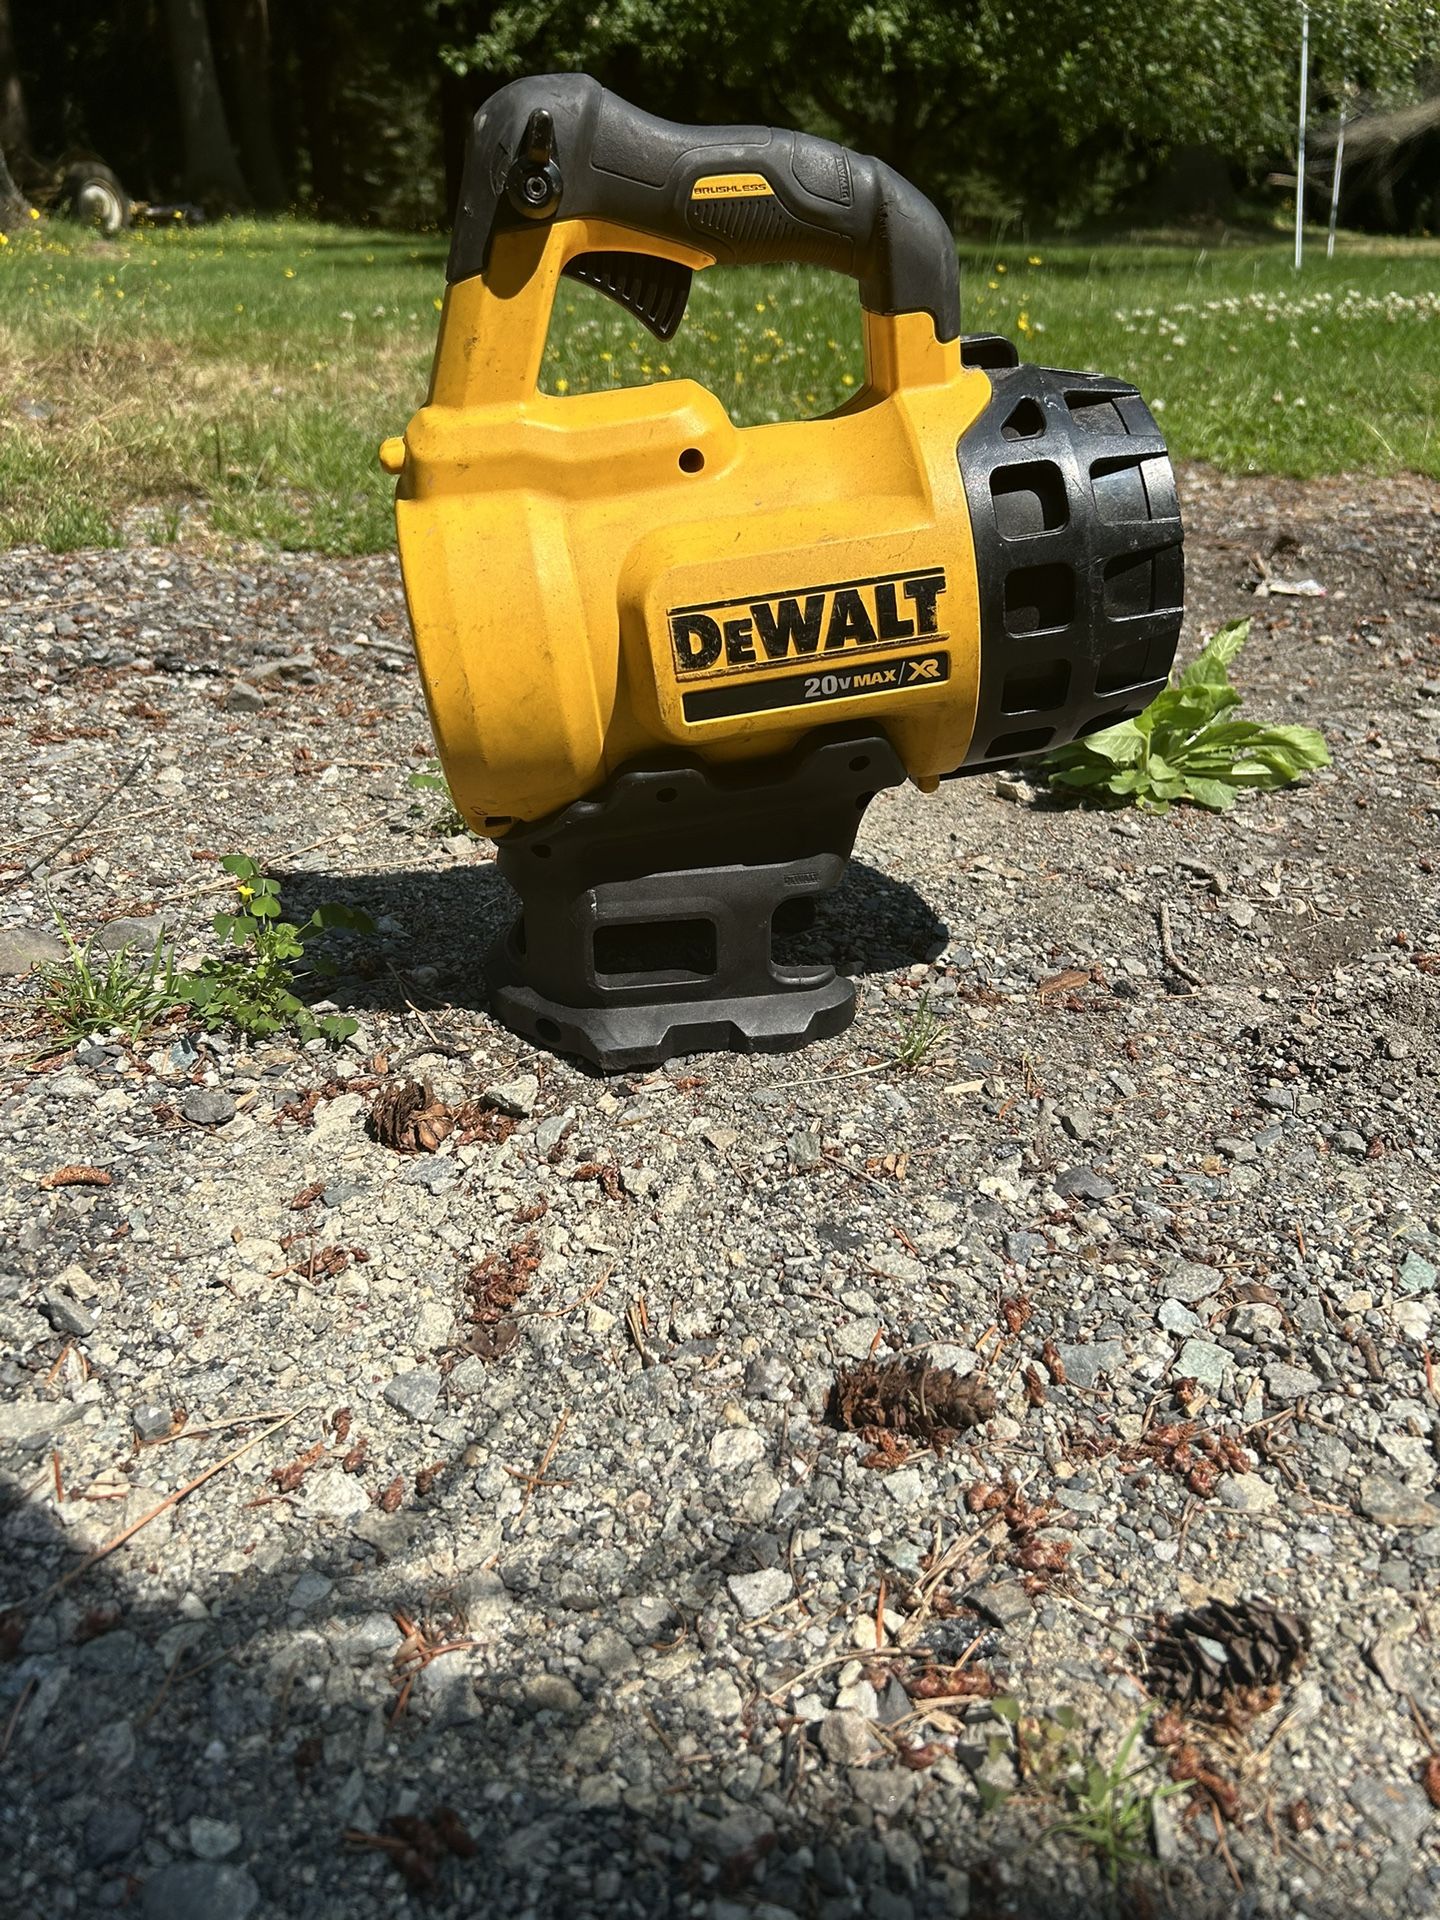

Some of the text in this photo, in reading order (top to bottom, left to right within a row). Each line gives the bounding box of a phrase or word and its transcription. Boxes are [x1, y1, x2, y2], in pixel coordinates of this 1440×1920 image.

[694, 183, 766, 195] BRUSHLESS
[671, 576, 946, 672] DEWALT
[853, 669, 896, 688] MAX
[908, 658, 941, 681] XR
